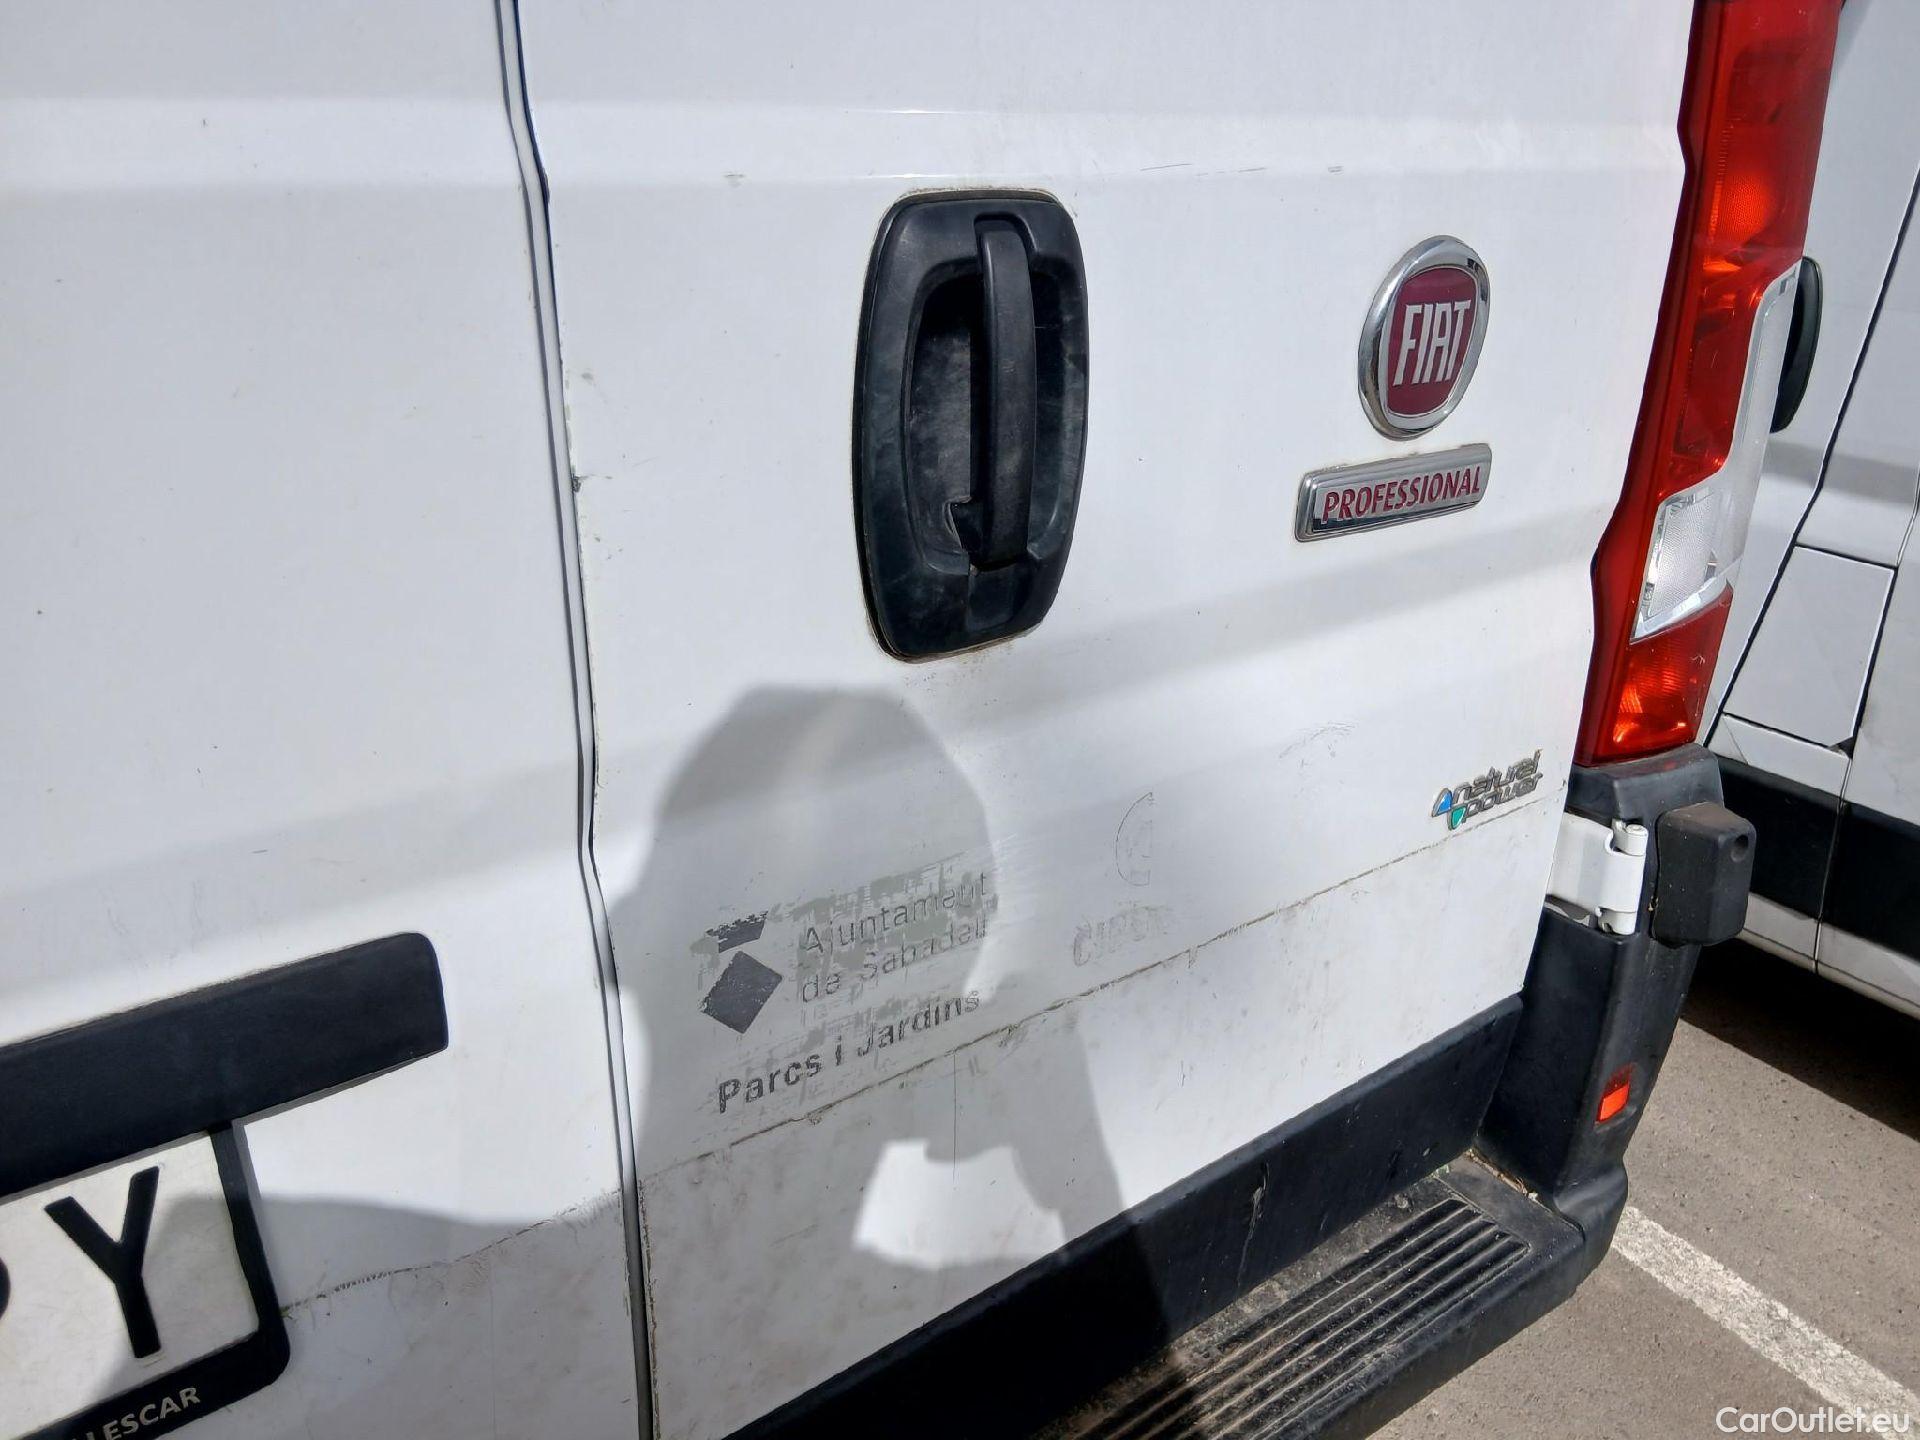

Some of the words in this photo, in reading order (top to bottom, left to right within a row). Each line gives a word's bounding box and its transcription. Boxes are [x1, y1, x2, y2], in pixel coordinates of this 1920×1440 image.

[1392, 300, 1472, 386] FIAT
[1321, 466, 1481, 524] PROFESSIONAL
[718, 1053, 823, 1115] Parcs
[856, 990, 981, 1058] Jardins
[0, 1165, 162, 1359] Y
